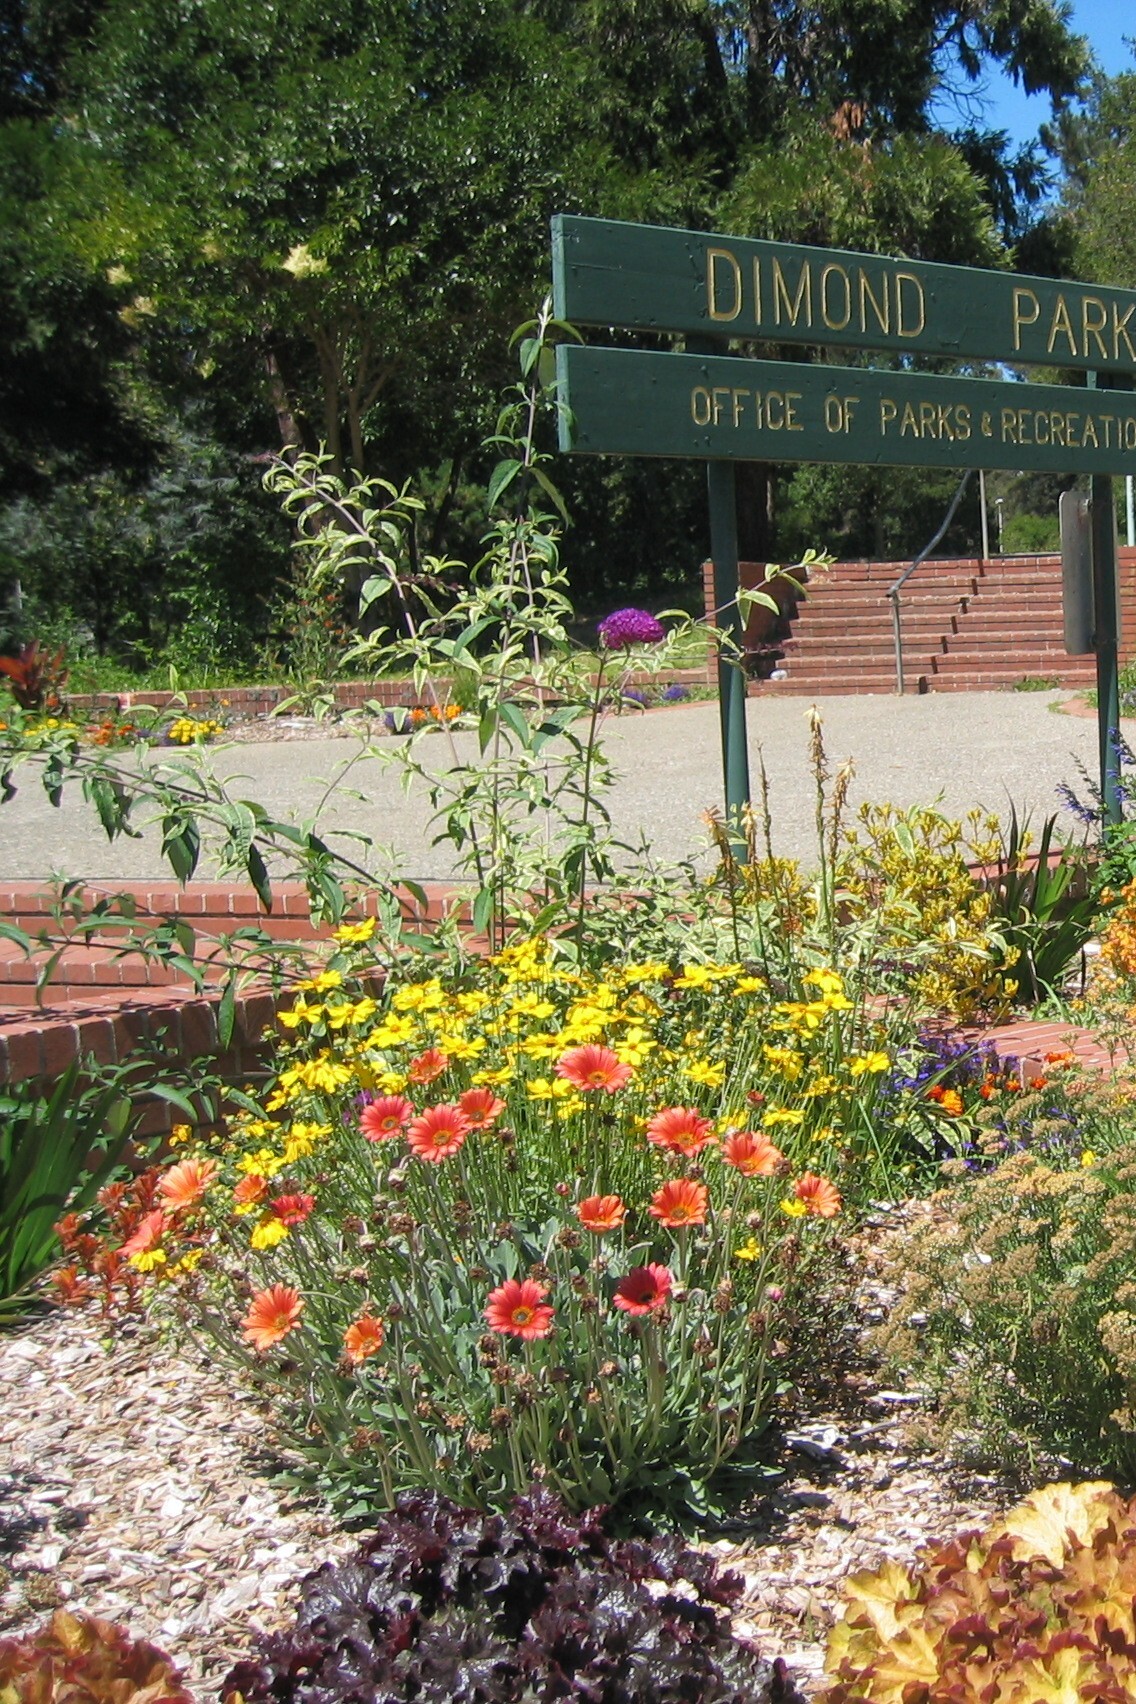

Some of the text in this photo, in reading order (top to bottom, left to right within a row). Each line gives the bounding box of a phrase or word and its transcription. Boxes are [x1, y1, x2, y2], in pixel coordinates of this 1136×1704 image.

[707, 248, 925, 337] DIMOND
[691, 386, 804, 431] OFFICE
[824, 395, 860, 434] OF
[880, 399, 971, 442] PARKS
[981, 411, 993, 437] &
